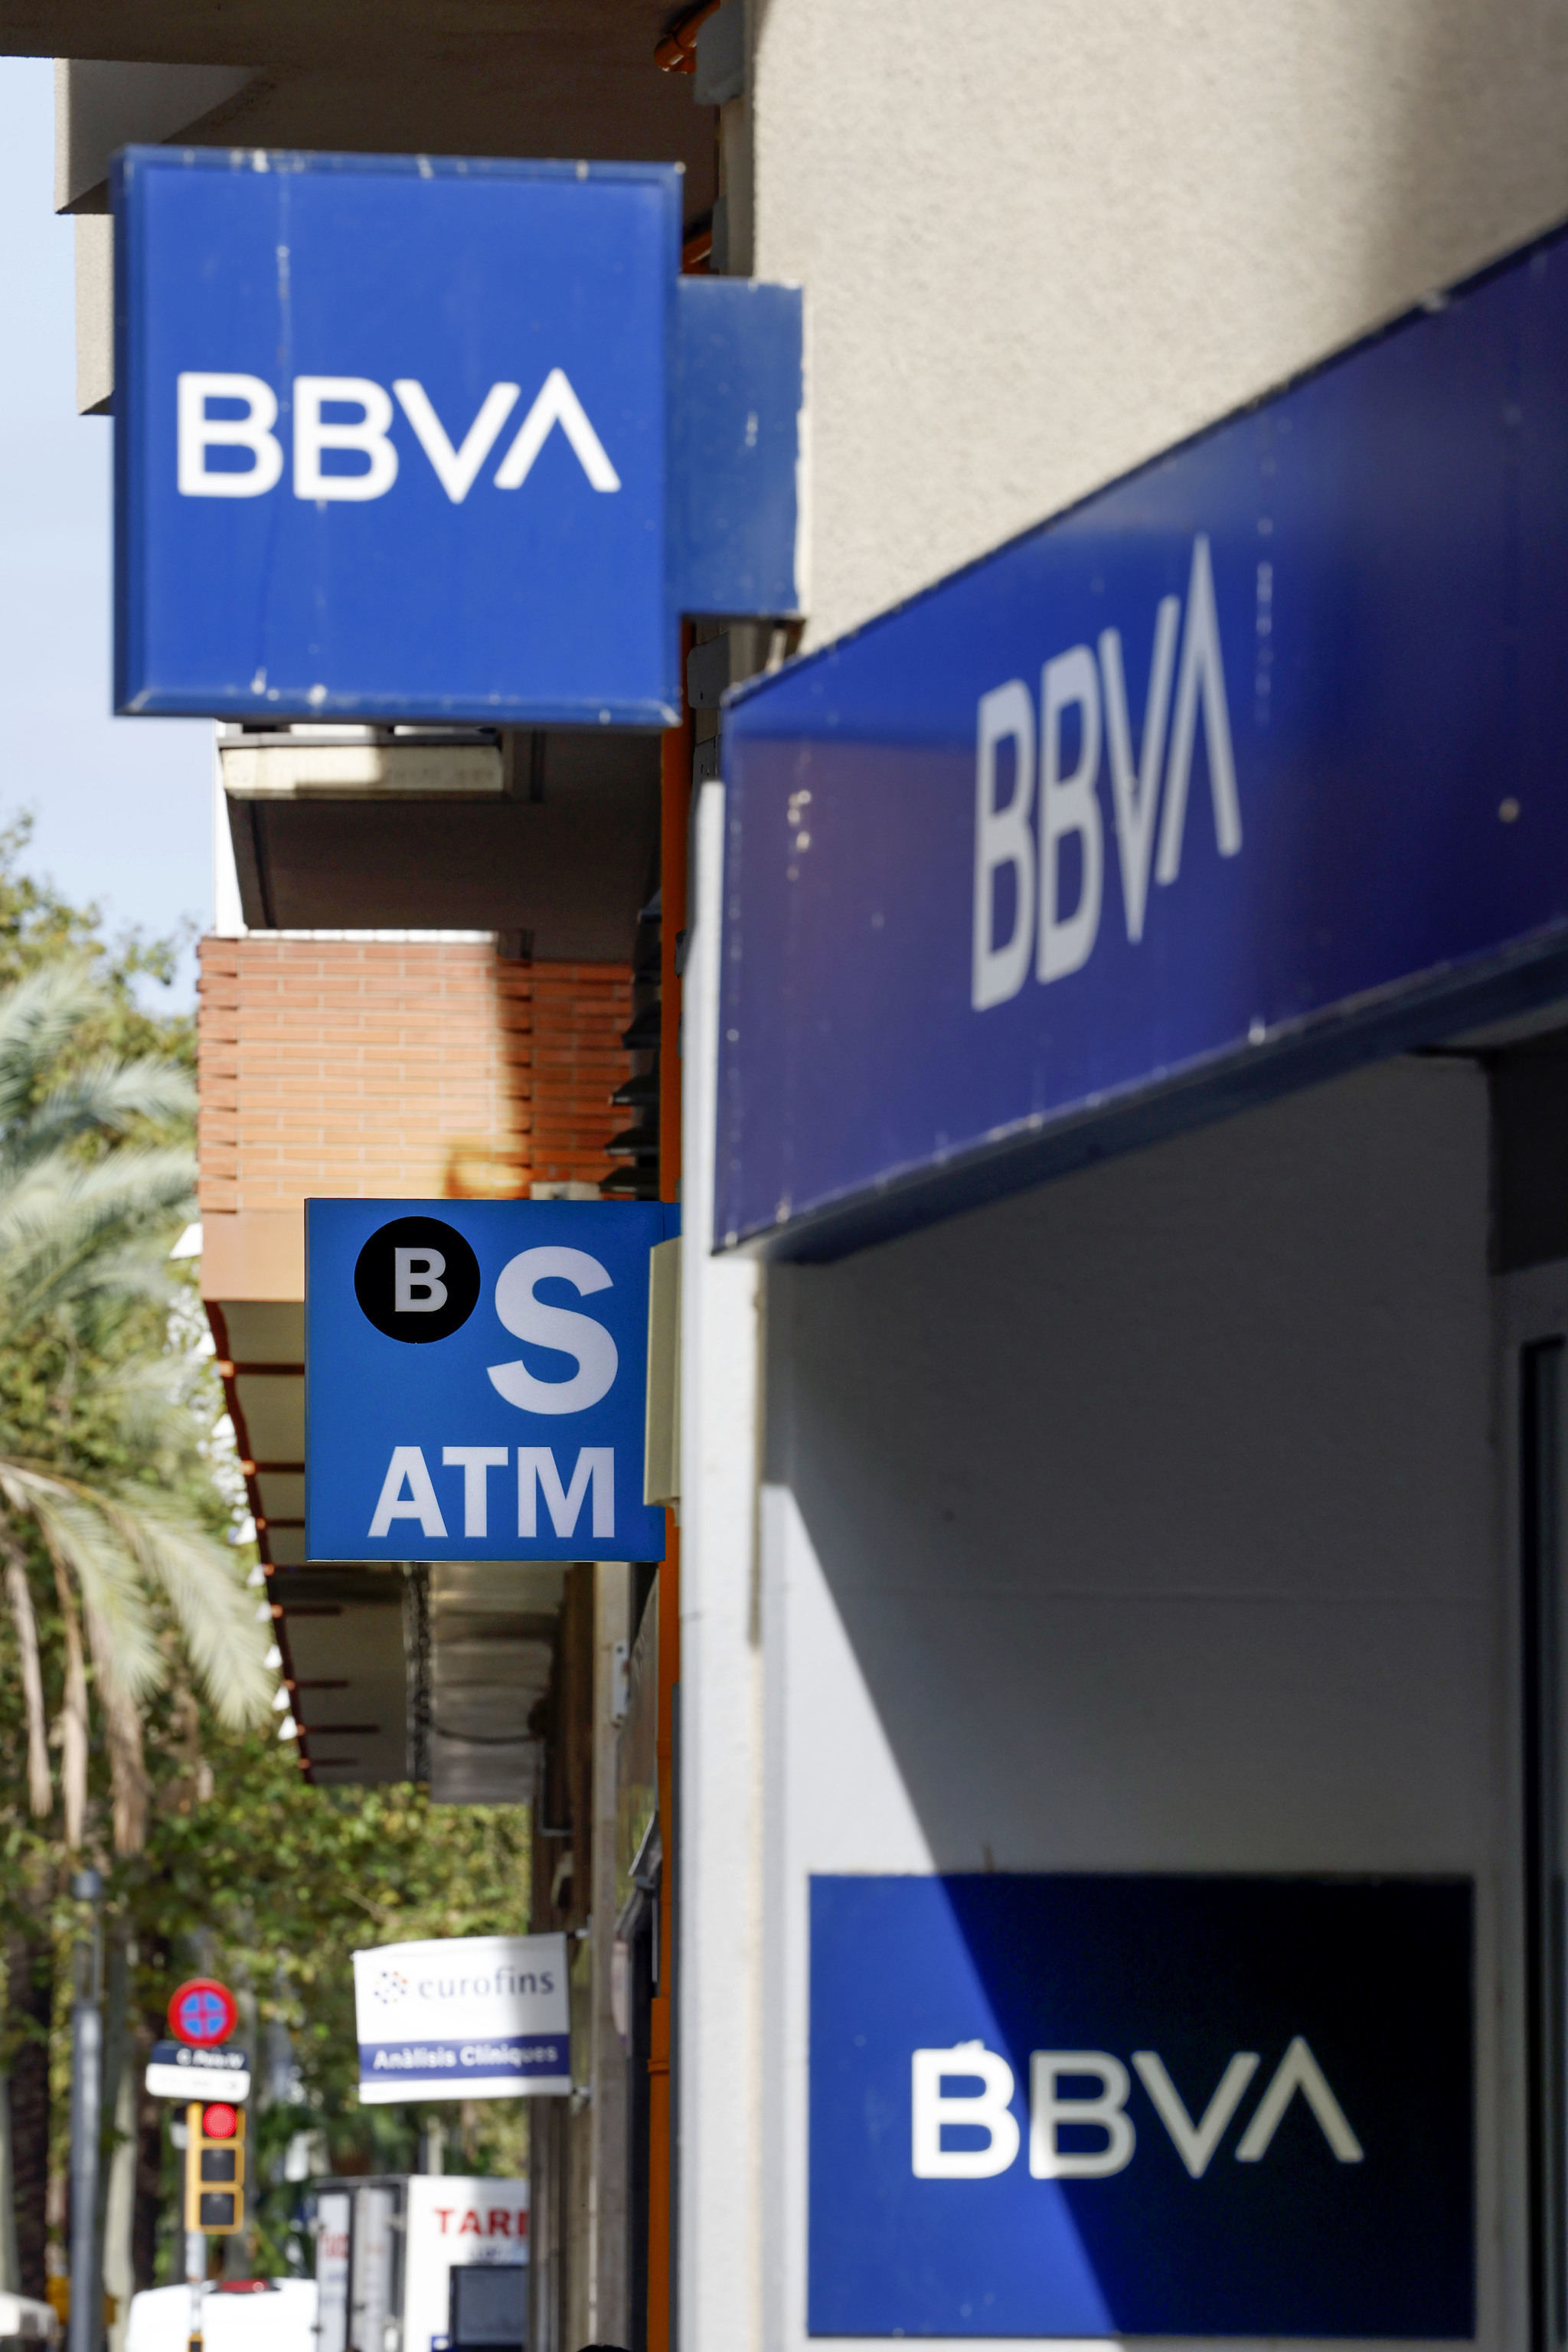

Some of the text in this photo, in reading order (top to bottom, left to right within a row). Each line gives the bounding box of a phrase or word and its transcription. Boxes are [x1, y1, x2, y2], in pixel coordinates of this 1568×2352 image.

[177, 367, 622, 504] BBVA
[971, 531, 1243, 1011] BBVA
[367, 1446, 615, 1538] ATM
[418, 1965, 555, 1999] eurofins
[911, 2036, 1364, 2180] BBVA
